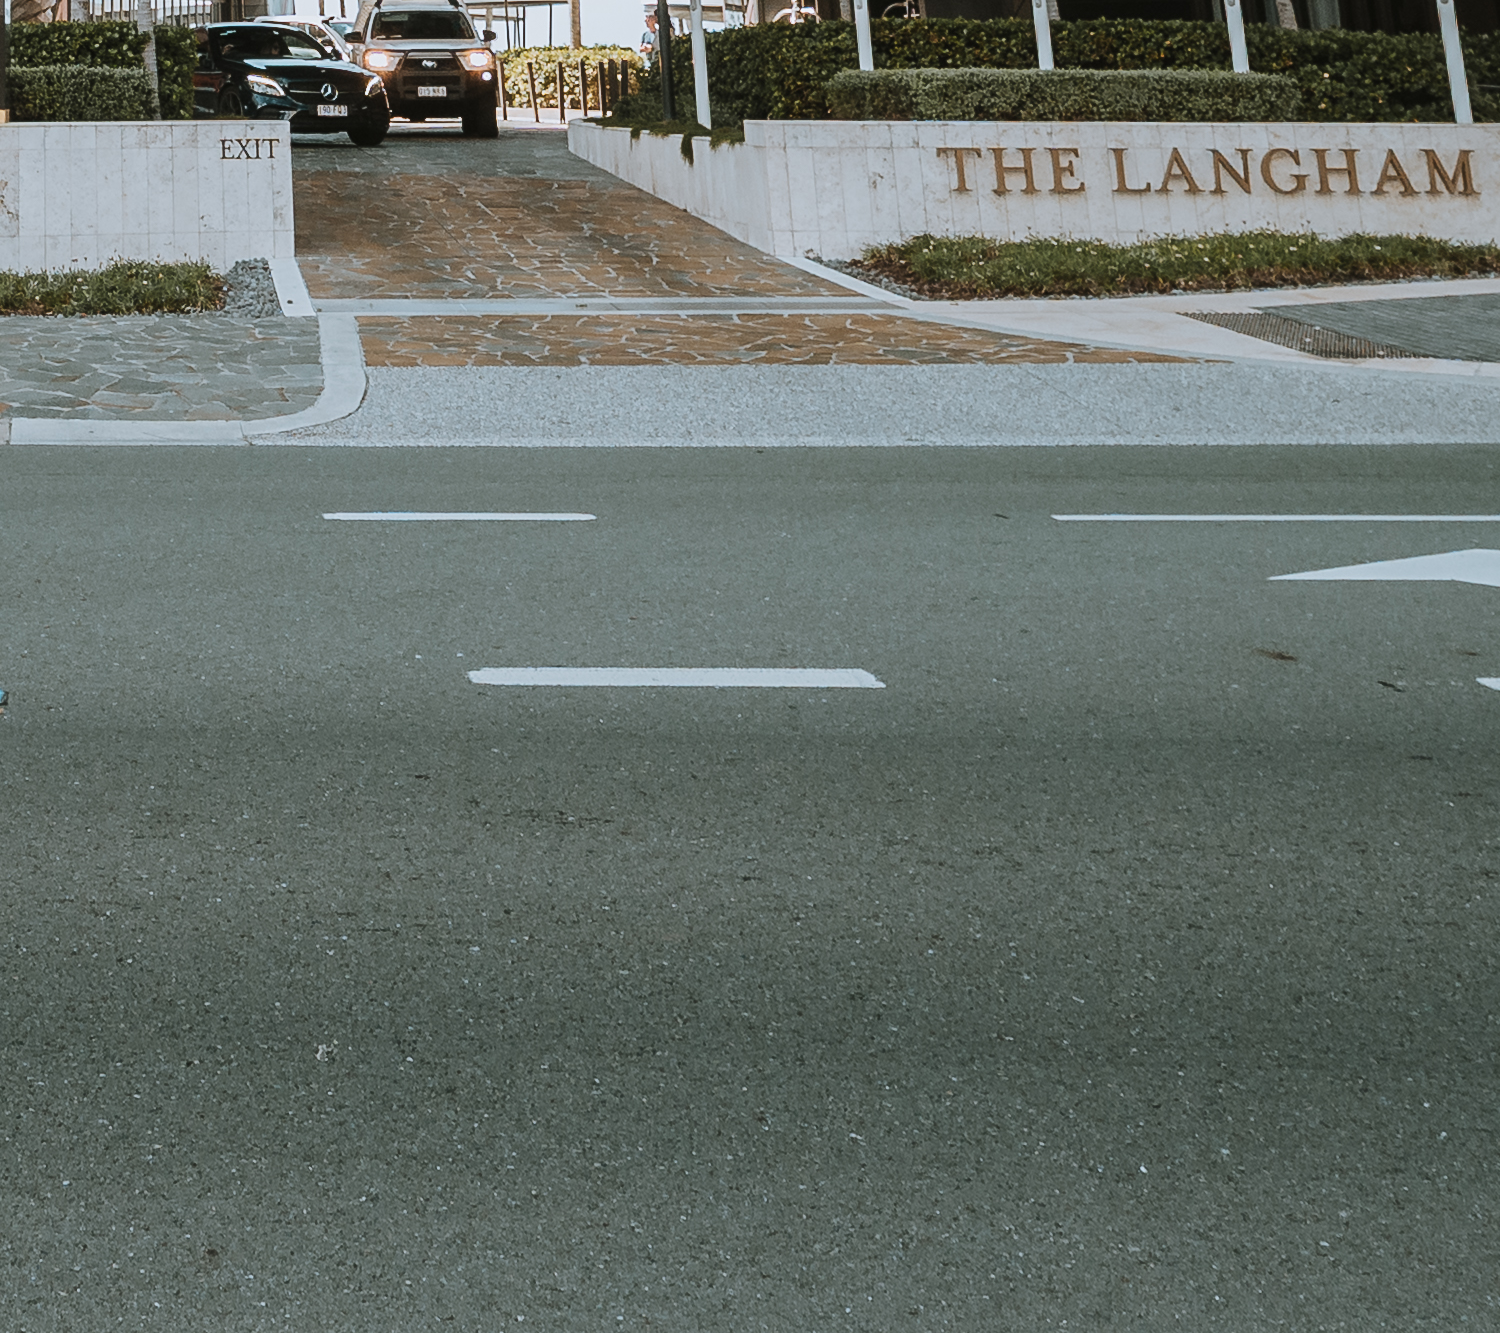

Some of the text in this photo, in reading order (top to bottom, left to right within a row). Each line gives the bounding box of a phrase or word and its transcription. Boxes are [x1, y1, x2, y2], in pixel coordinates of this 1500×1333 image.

[220, 139, 280, 160] EXIT
[936, 147, 1481, 196] THE LANGHAM
